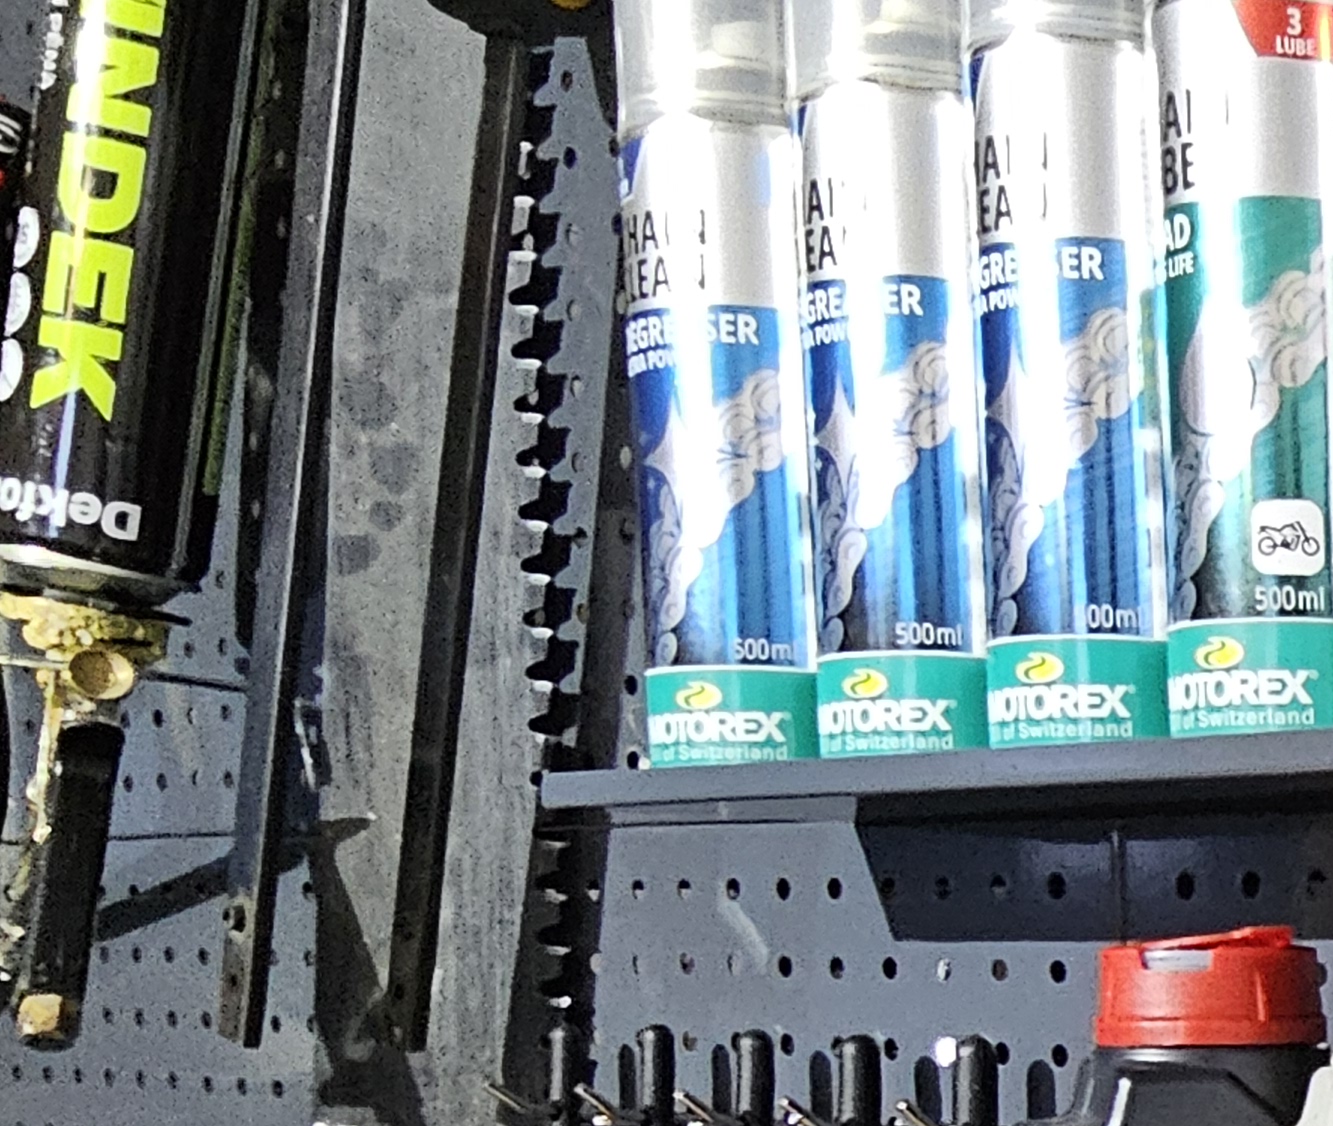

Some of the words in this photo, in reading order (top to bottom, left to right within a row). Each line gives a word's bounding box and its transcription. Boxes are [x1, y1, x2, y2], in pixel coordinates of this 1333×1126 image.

[1275, 35, 1316, 56] LUBE
[30, 0, 166, 421] INDEK
[978, 246, 1105, 289] GREER
[801, 283, 923, 324] GREER
[1254, 585, 1325, 612] 500ml
[1084, 604, 1143, 629] 00ml
[895, 622, 963, 646] 500ml
[1017, 720, 1133, 739] Switzerland
[1198, 707, 1315, 728] Switzerland
